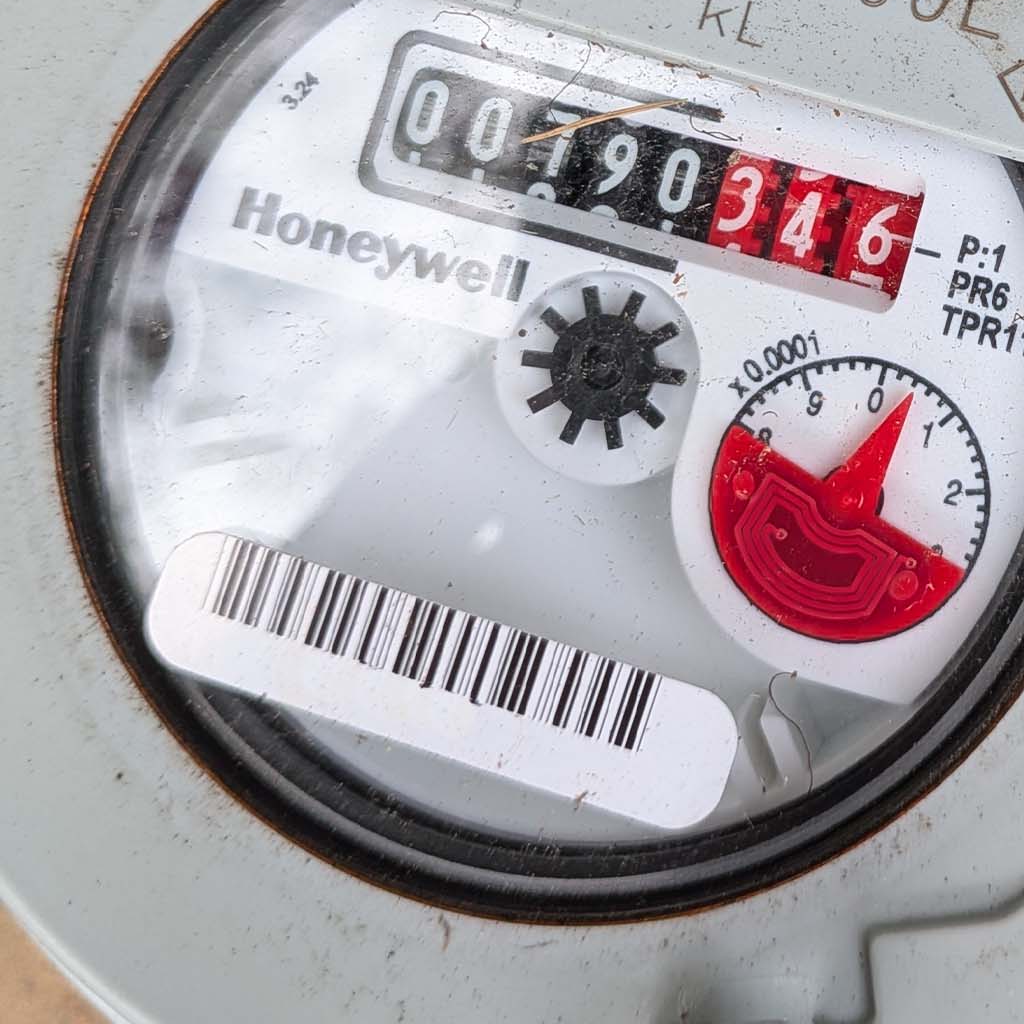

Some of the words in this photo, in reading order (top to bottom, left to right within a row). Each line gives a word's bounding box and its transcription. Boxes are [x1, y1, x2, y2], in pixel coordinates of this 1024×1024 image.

[231, 186, 531, 302] Honeywell
[957, 233, 1007, 274] P:1
[946, 268, 1011, 312] PR6
[806, 389, 824, 417] 9
[866, 386, 884, 414] 0
[921, 421, 934, 450] 1
[943, 479, 963, 506] 2
